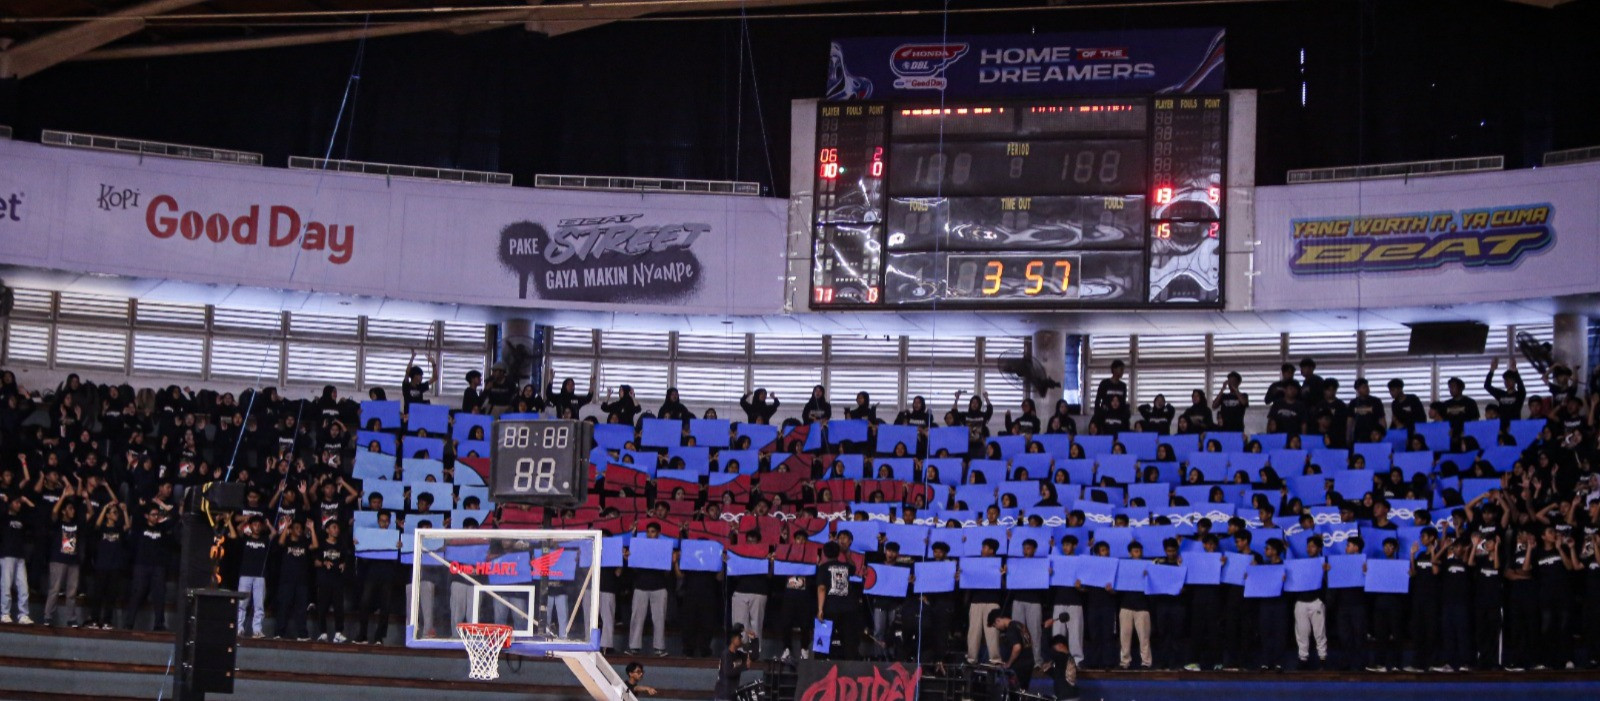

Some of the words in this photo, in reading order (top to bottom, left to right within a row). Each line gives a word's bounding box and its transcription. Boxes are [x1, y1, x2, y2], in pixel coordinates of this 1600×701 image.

[981, 46, 1071, 65] HOME
[979, 63, 1156, 83] DREAMERS
[822, 106, 840, 116] PLAYER
[846, 106, 862, 116] FOULS
[868, 105, 884, 115] POINT
[1155, 99, 1174, 110] PLAYER
[1181, 99, 1198, 109] FOULS
[1204, 99, 1220, 109] POINT
[820, 148, 838, 163] 06
[873, 146, 883, 161] 2
[1007, 142, 1030, 156] PERIOD
[1156, 187, 1172, 204] 13
[1001, 198, 1016, 210] TIME
[1019, 198, 1031, 210] OUT
[1104, 197, 1124, 210] FOULS
[146, 195, 260, 246] Good
[269, 205, 355, 265] Day
[1293, 220, 1349, 239] YANG
[1353, 215, 1429, 236] WORTH
[1462, 212, 1490, 230] YA
[1490, 207, 1549, 227] CUMA
[1157, 223, 1171, 239] 15
[509, 237, 540, 255] PAKE
[544, 222, 712, 264] STREET
[545, 269, 579, 289] GAYA
[584, 265, 628, 288] MAKIN
[982, 260, 1003, 295] 3
[1024, 260, 1071, 295] 57
[449, 561, 474, 575] One
